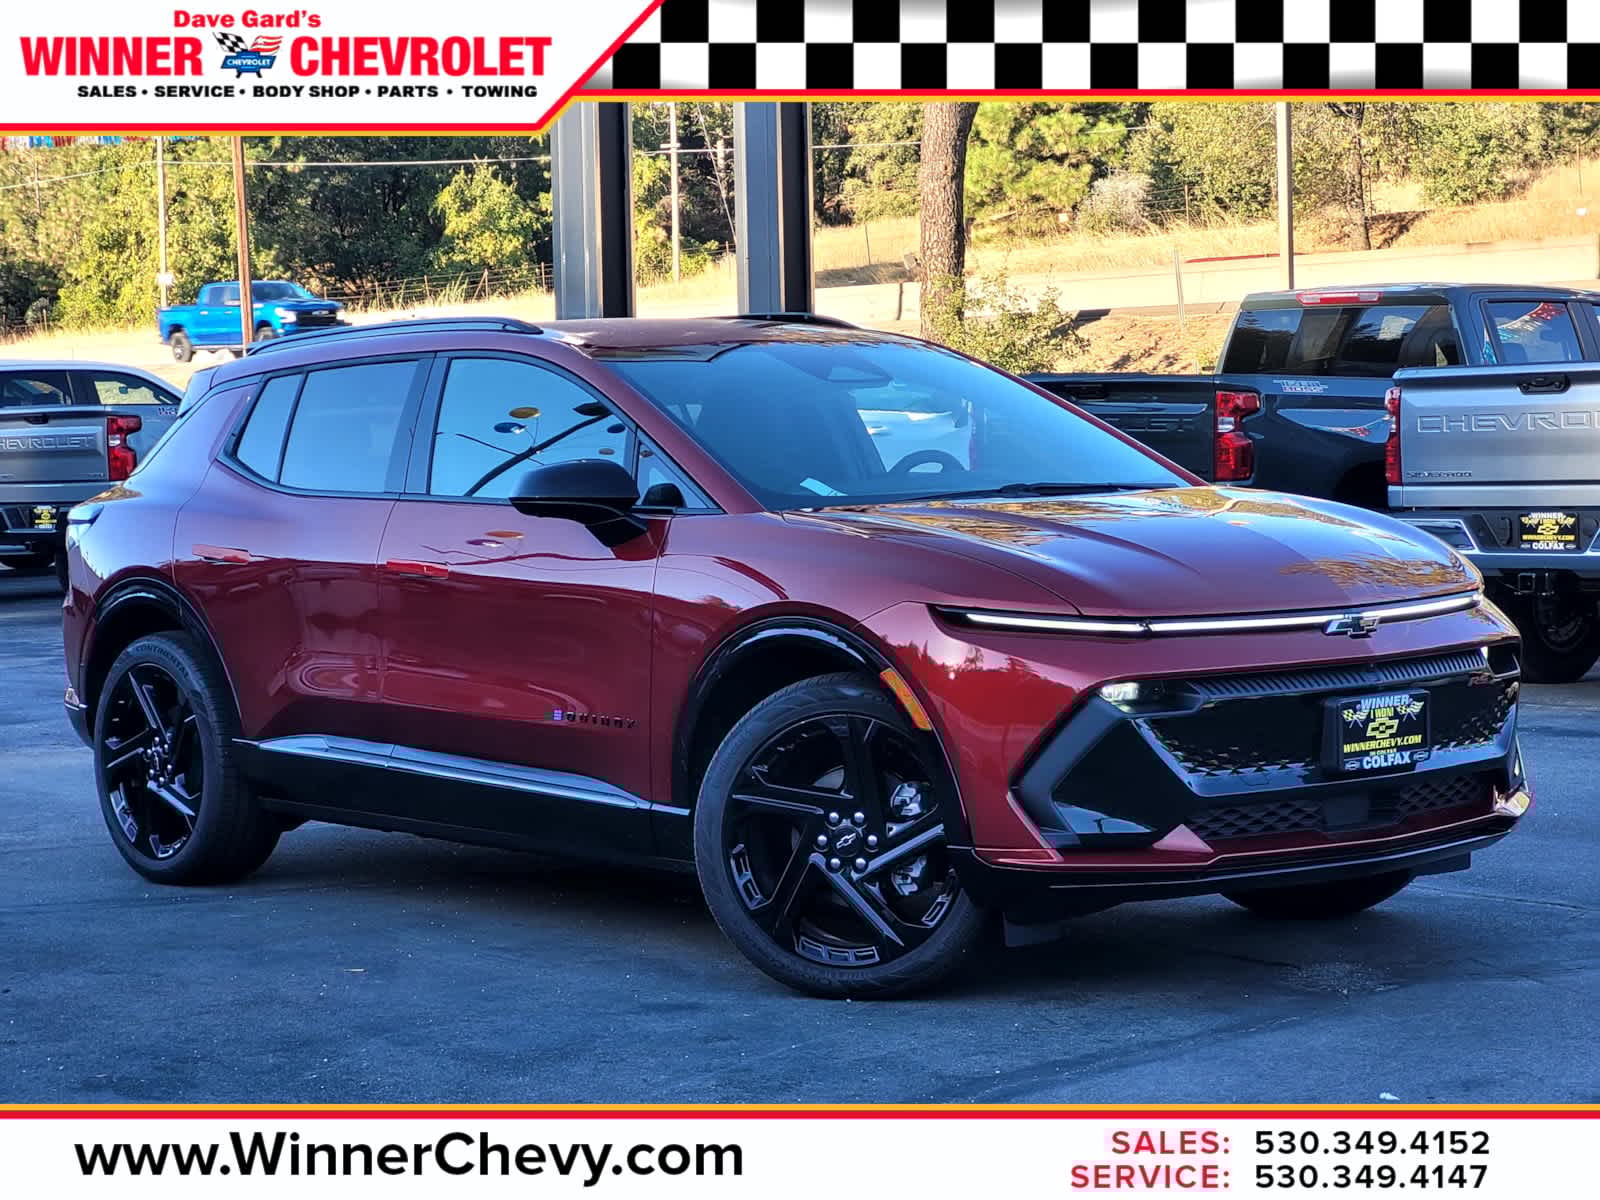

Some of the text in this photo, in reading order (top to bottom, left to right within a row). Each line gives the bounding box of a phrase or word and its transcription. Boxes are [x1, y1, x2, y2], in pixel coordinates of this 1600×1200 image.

[1417, 410, 1600, 433] CHEVRO
[1532, 542, 1565, 550] COLFAX
[1361, 695, 1410, 712] WINNER
[1343, 734, 1422, 753] WINNERCHEVY.COM
[1362, 751, 1411, 769] COLFAX
